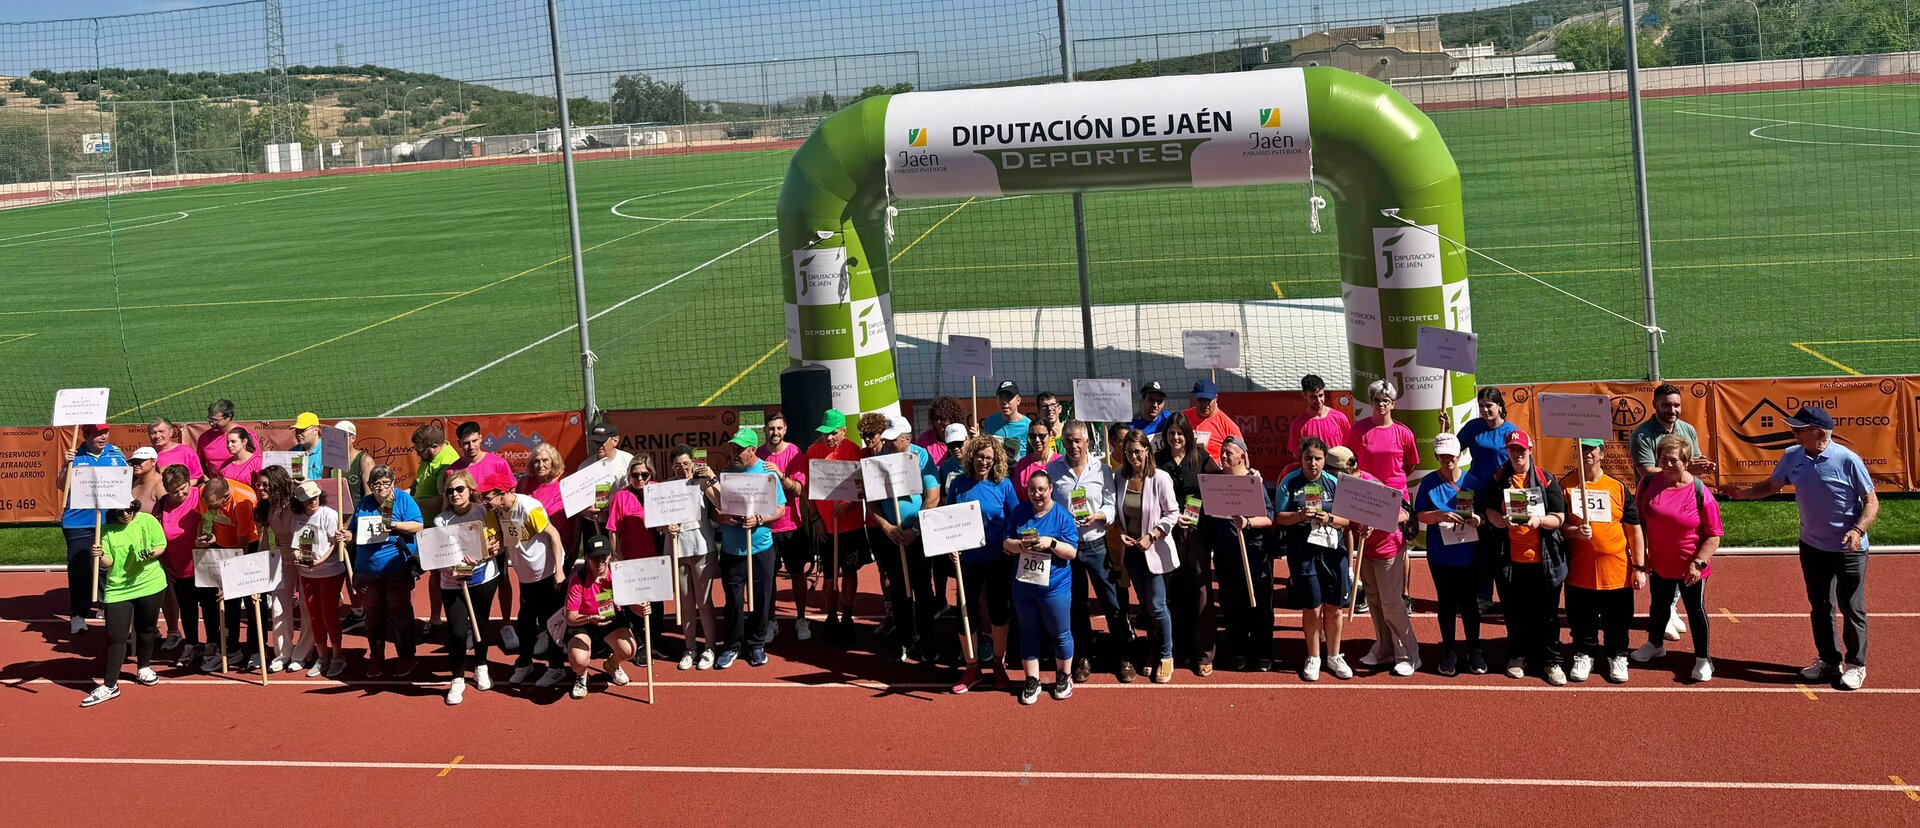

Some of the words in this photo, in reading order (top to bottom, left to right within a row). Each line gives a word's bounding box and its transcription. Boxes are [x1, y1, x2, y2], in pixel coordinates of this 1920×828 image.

[953, 115, 1113, 146] DIPUTACIÓN
[1121, 114, 1157, 137] DE
[1164, 107, 1233, 136] JAÉN
[1249, 131, 1293, 150] Jaén
[1001, 143, 1184, 170] DEPORTES
[1242, 149, 1270, 157] PARAÍSO
[1271, 148, 1302, 156] INTERIOR
[899, 150, 939, 168] Jaén
[1394, 252, 1435, 261] DIPUTACIÓN
[817, 279, 832, 287] JAÉN
[1388, 313, 1439, 323] DEPORTES
[804, 327, 847, 336] DEPORTES
[1416, 382, 1433, 390] JAÉN
[1786, 395, 1838, 410] Daniel
[676, 414, 717, 422] PATROCINADOR
[1833, 414, 1890, 427] arrasco
[619, 429, 734, 450] ARNICERIA
[19, 470, 45, 479] ARROYO
[16, 498, 36, 510] 469
[508, 526, 519, 537] 65
[1023, 558, 1044, 573] 204
